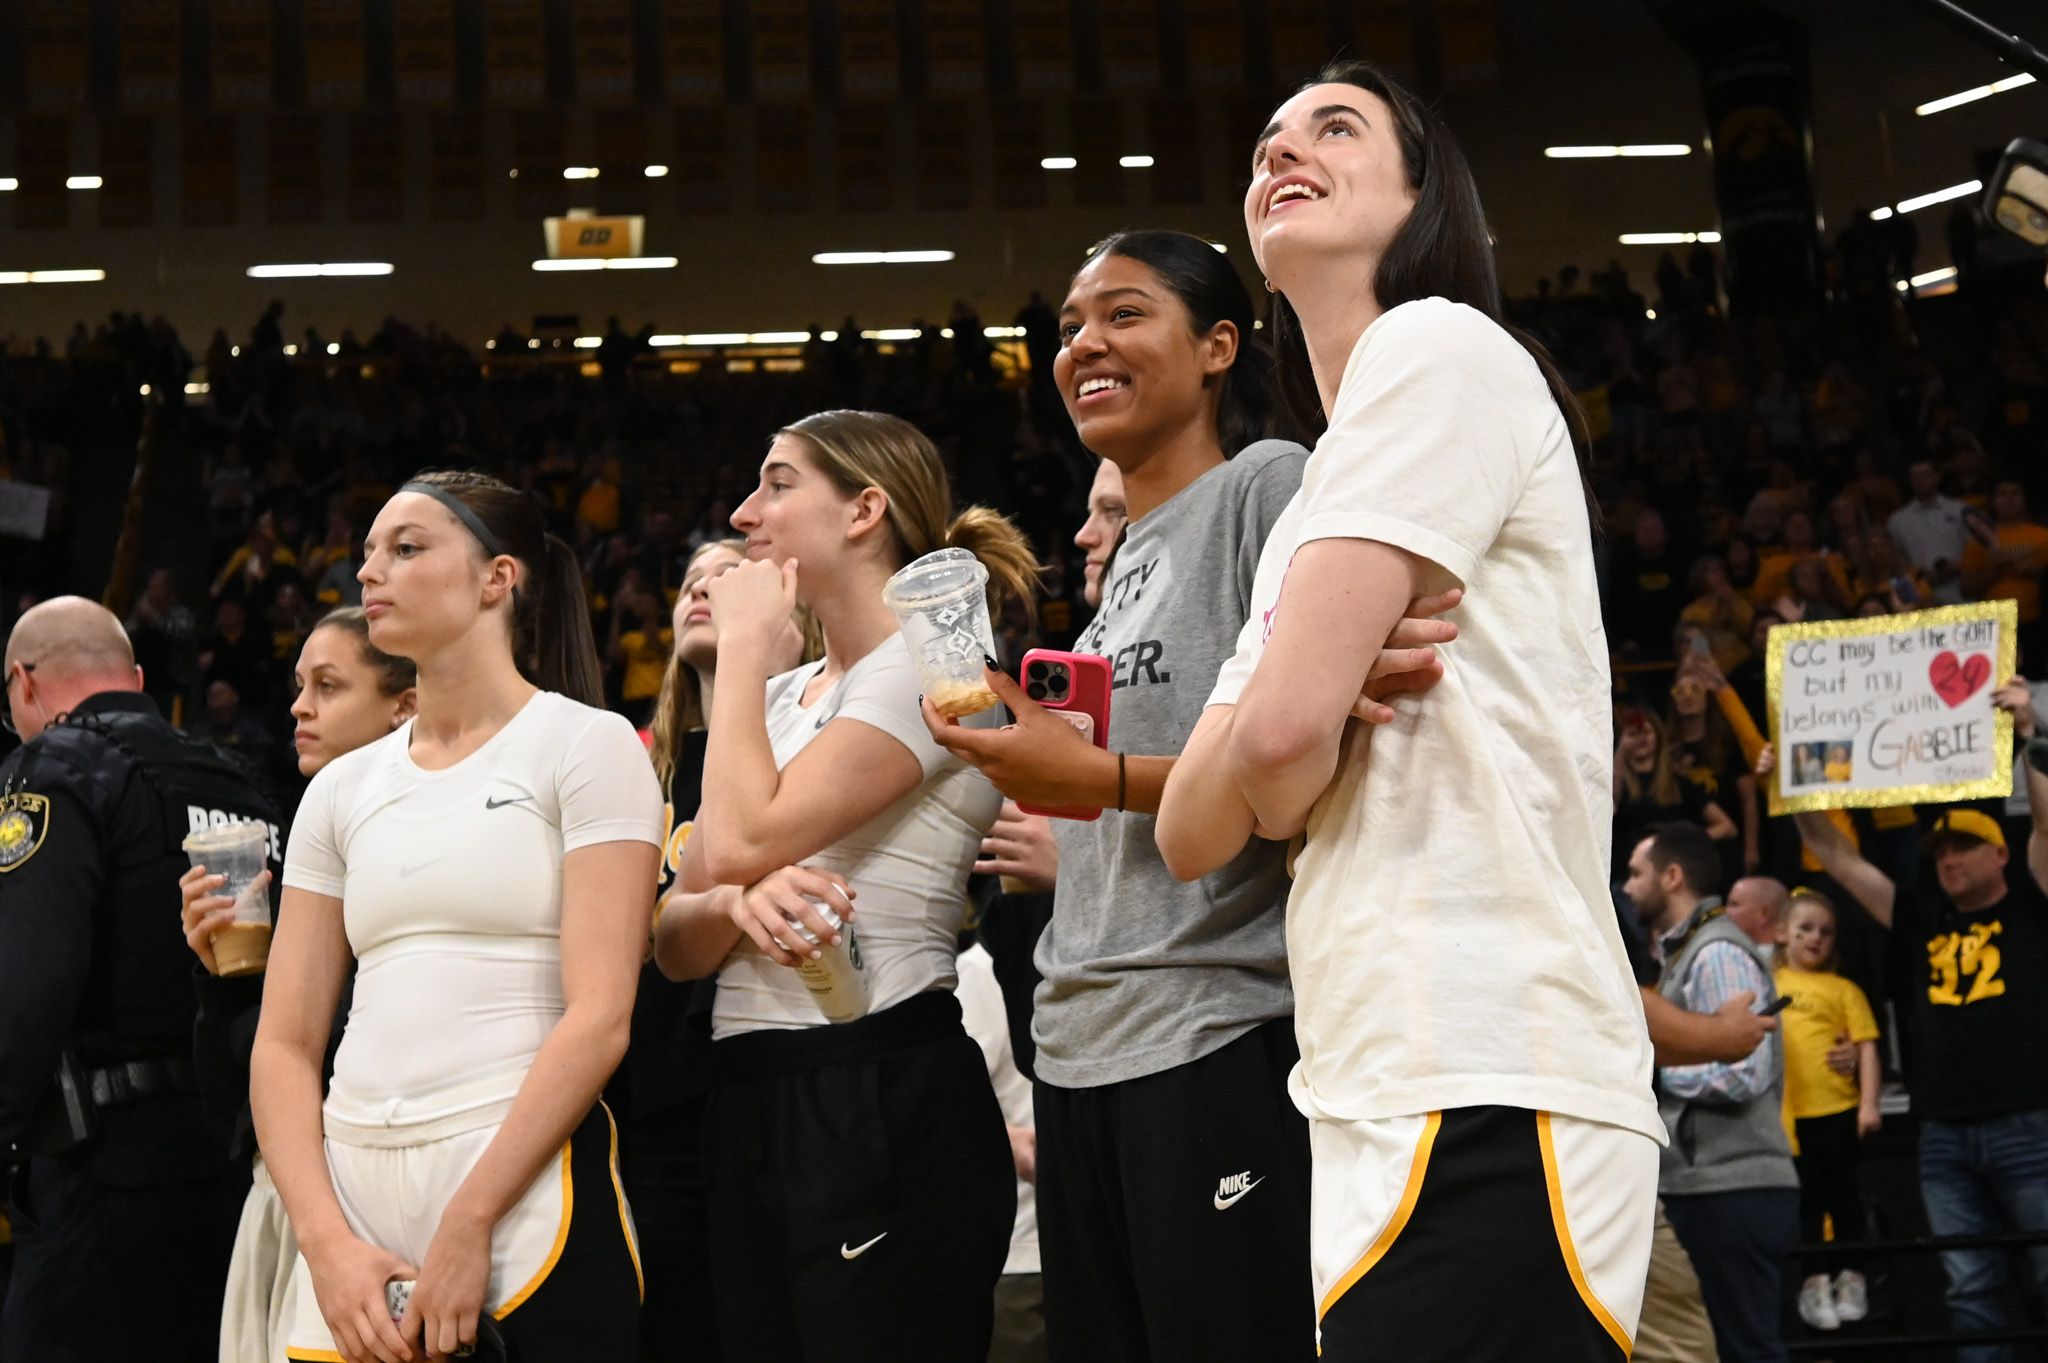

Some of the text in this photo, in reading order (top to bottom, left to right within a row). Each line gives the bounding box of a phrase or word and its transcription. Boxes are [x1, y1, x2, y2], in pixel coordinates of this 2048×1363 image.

[1108, 640, 1171, 690] ER.
[1789, 640, 1827, 668] CC
[1839, 642, 1875, 668] may
[1888, 634, 1914, 656] be
[1804, 669, 1846, 697] but
[1865, 671, 1902, 699] my
[1784, 702, 1876, 739] belongs
[187, 805, 282, 862] POCE
[1219, 1170, 1251, 1196] NIKE
